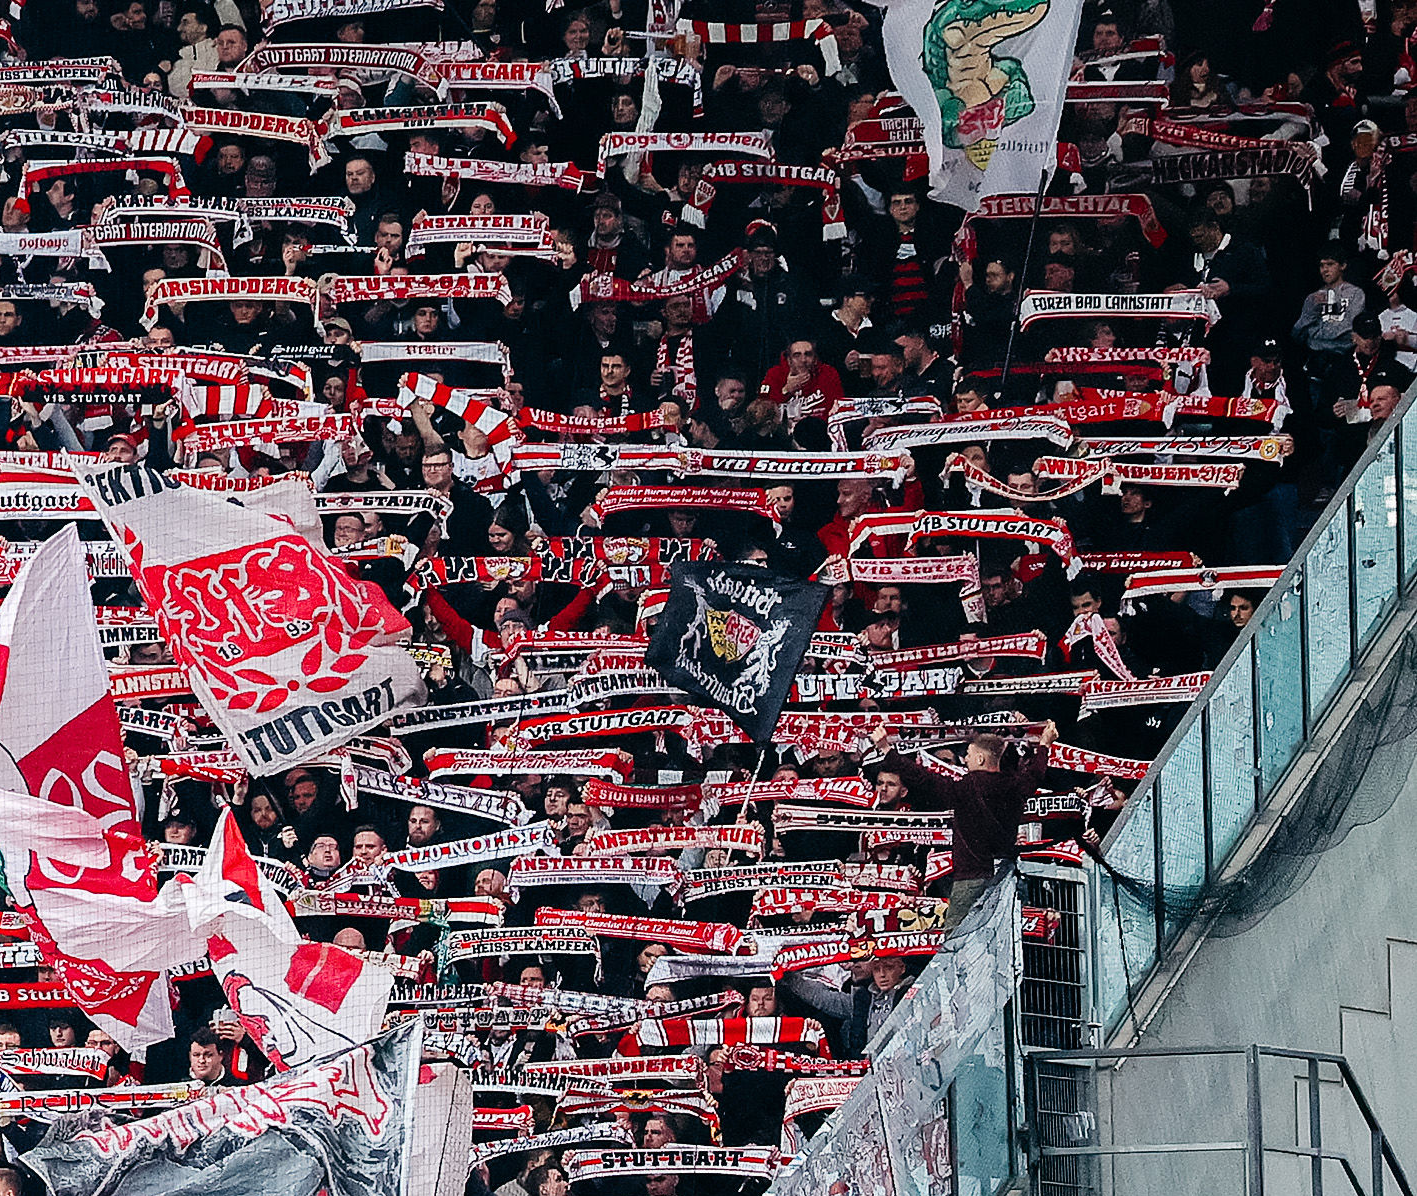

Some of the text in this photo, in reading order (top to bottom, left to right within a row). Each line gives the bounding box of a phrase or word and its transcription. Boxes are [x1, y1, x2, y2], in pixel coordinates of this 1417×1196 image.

[258, 48, 326, 66] STUTTGART
[70, 393, 142, 403] STUTTGART
[711, 457, 857, 475] VfB Stuttgart
[911, 512, 1059, 541] VfB STUTTGART
[537, 710, 681, 741] VfB STUTTGART
[600, 1150, 745, 1170] STUTTGART
